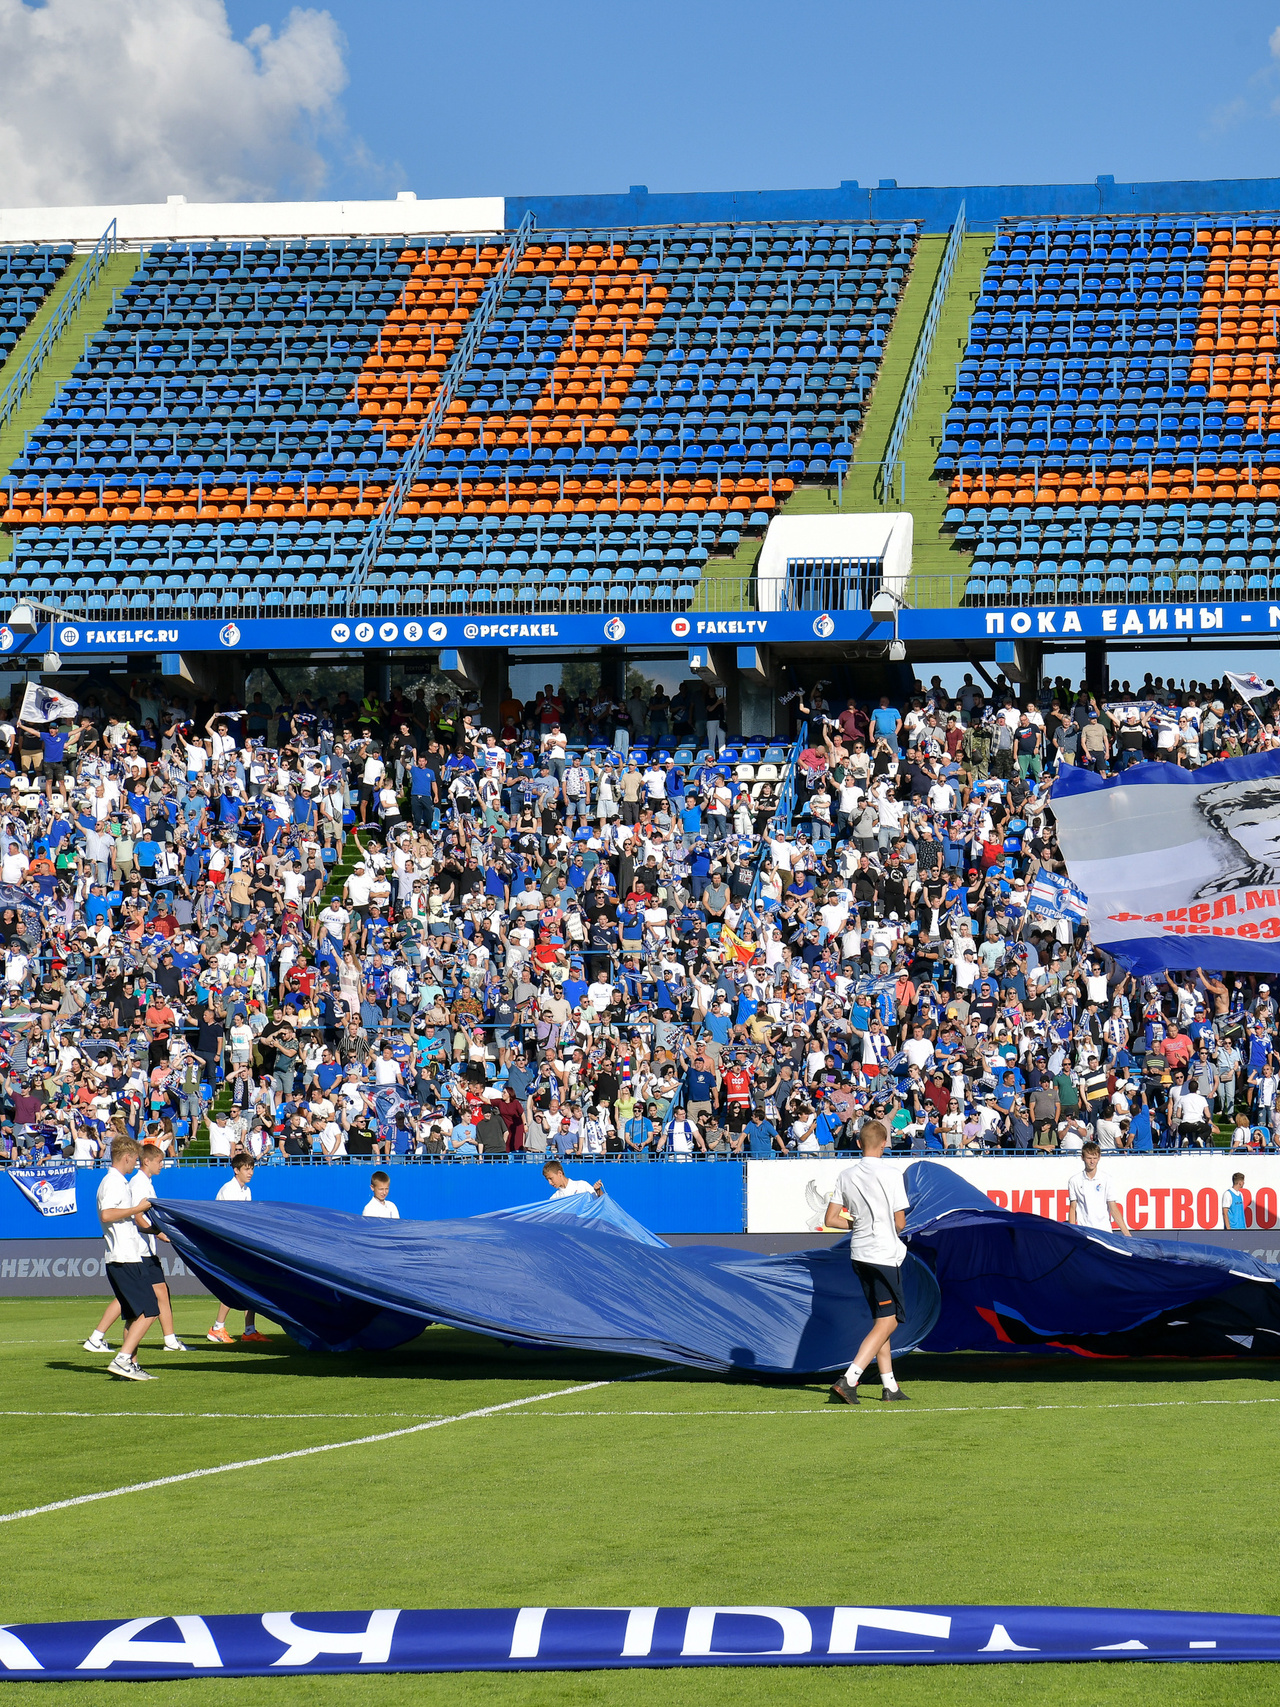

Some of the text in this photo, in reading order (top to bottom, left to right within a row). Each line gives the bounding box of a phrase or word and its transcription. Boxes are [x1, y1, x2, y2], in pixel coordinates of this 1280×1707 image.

[696, 620, 768, 634] FAKELTV
[984, 611, 1083, 634] ПОКА
[1101, 607, 1223, 635] ЕДИНЫ
[86, 629, 179, 644] FAKELFC.RU
[463, 623, 559, 639] @PFCFAKEL
[43, 1203, 75, 1214] ВСЮДУ
